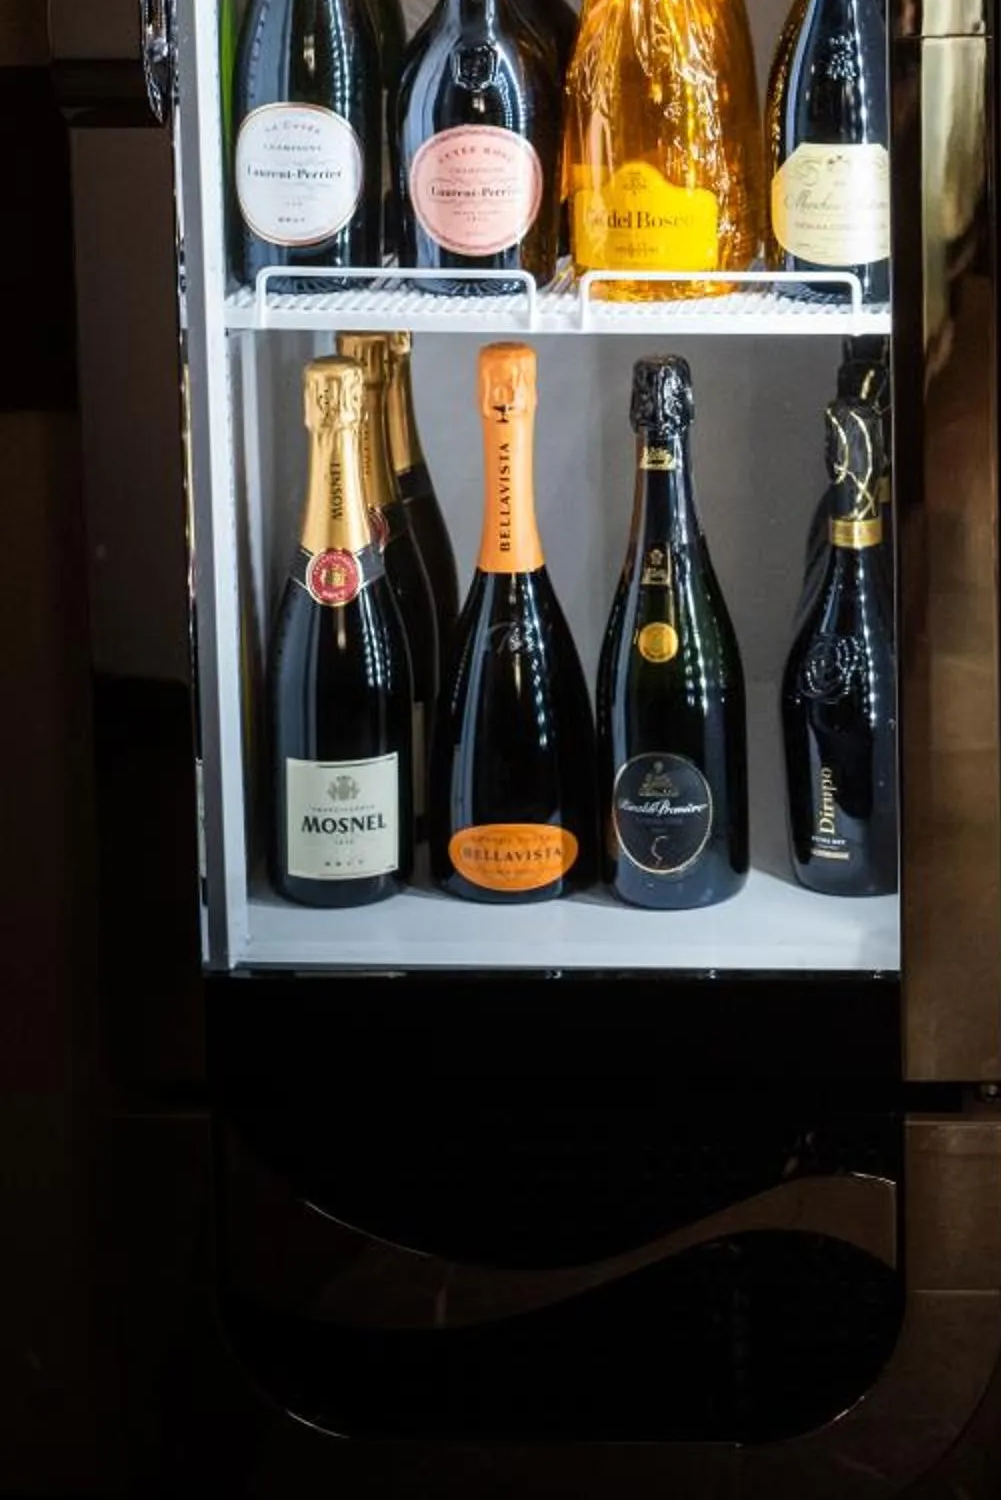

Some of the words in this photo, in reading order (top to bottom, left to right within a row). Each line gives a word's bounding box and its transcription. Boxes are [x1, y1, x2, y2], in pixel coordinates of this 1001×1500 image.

[247, 166, 343, 180] Laurent-Perrier
[499, 440, 511, 553] BELLAVISTA
[819, 766, 833, 834] Dirupo
[302, 813, 386, 835] MOSNEL
[462, 845, 563, 862] BELLAVISTA
